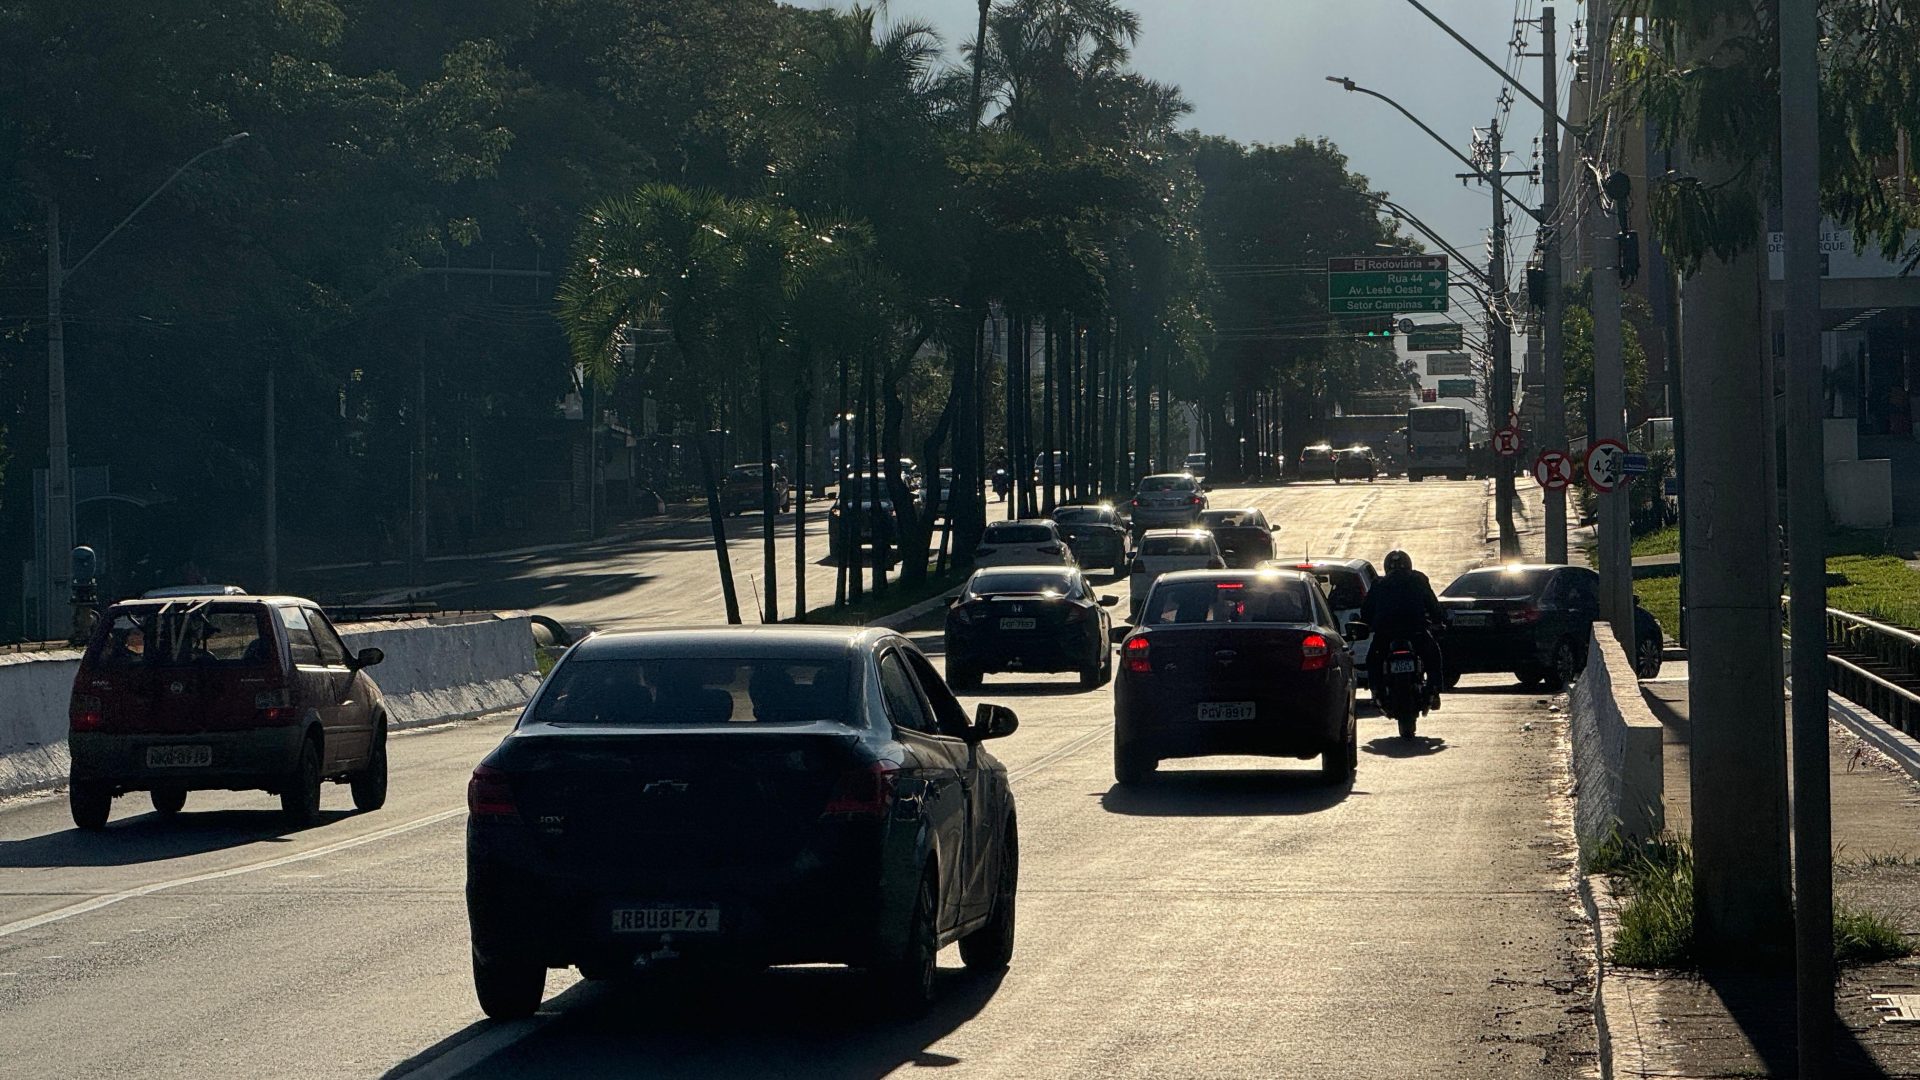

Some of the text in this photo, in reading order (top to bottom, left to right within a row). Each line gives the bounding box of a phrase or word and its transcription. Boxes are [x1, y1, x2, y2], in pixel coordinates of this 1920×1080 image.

[1368, 260, 1422, 269] Rodoviária
[1388, 274, 1422, 283] Rua 44
[1348, 285, 1423, 295] Av. Leste Oeste
[1347, 300, 1423, 310] Setor Campinas
[621, 910, 708, 929] RBU8F76
